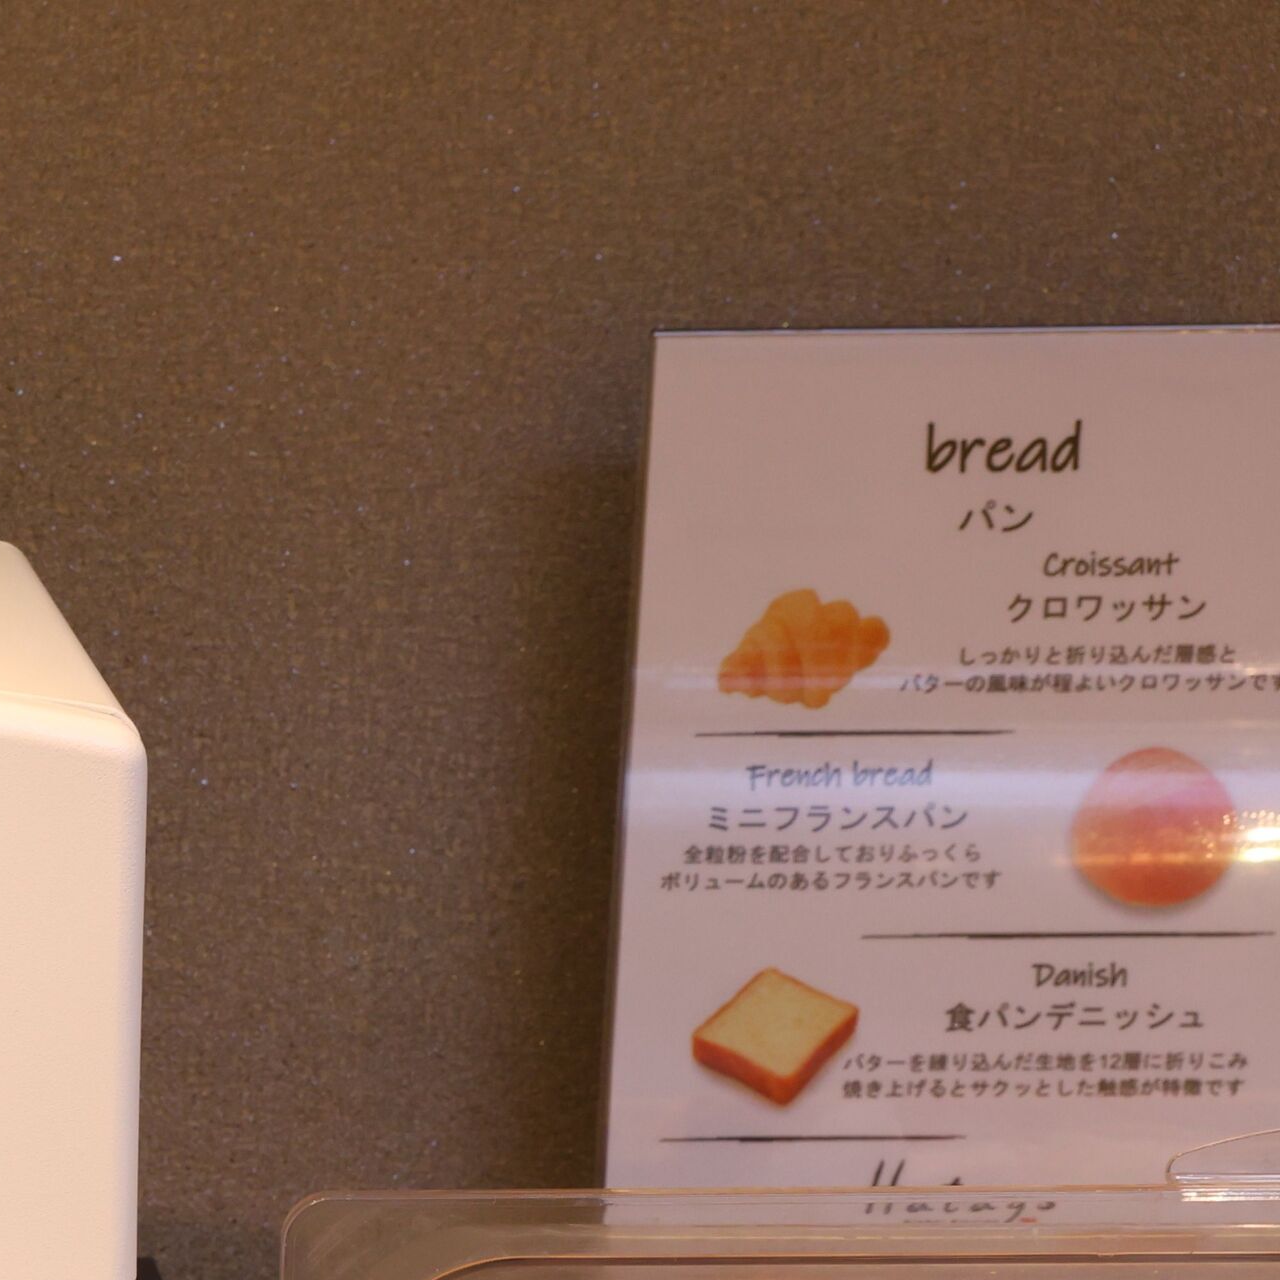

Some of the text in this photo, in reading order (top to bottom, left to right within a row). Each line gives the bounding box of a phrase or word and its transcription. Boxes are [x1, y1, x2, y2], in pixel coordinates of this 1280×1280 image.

[925, 419, 1082, 475] bread
[958, 500, 1033, 534] パン
[1042, 551, 1180, 579] Croissant
[1007, 592, 1207, 623] クロワッサン
[746, 758, 935, 791] French bread
[1032, 962, 1129, 988] Danish
[945, 1001, 1205, 1032] 食パンデニッシュ
